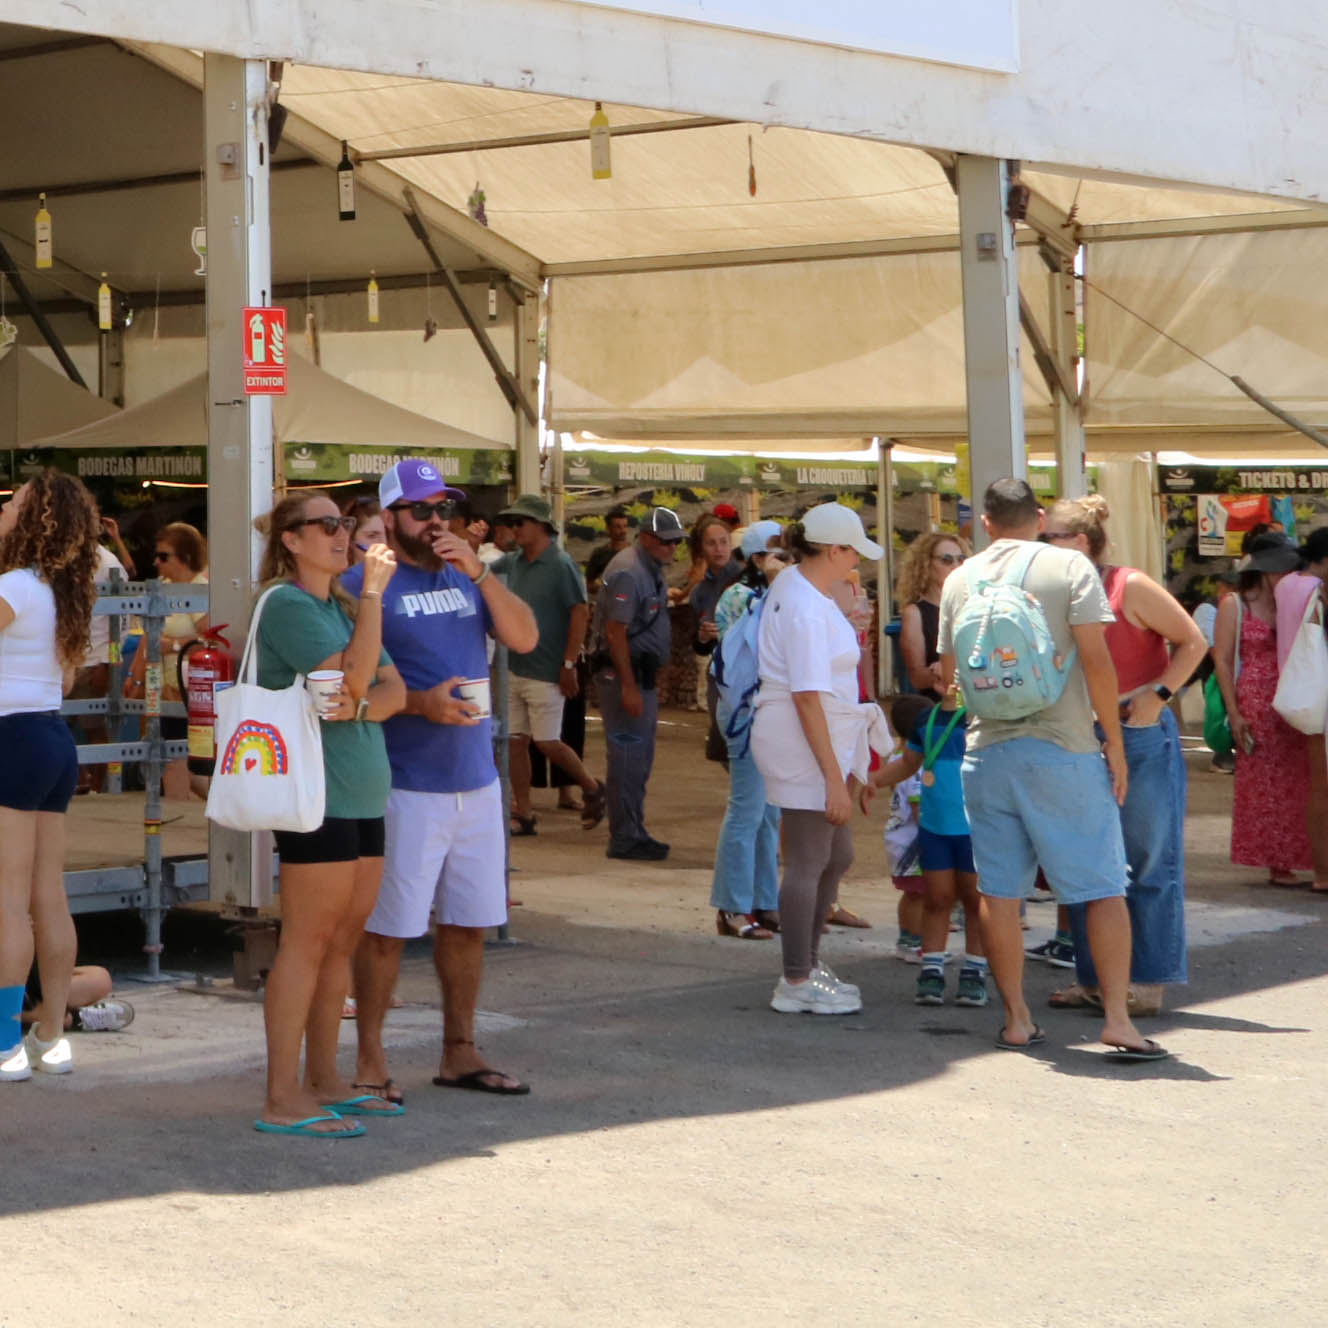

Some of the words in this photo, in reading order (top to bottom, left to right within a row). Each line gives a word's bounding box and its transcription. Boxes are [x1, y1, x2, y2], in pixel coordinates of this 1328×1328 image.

[247, 376, 283, 387] EXTINTOR
[78, 457, 133, 476] BODEGAS
[135, 450, 201, 476] MARTINÓN
[797, 467, 808, 484] LA
[1238, 472, 1296, 489] TICKETS
[1297, 473, 1310, 489] &
[401, 587, 469, 618] PUMA
